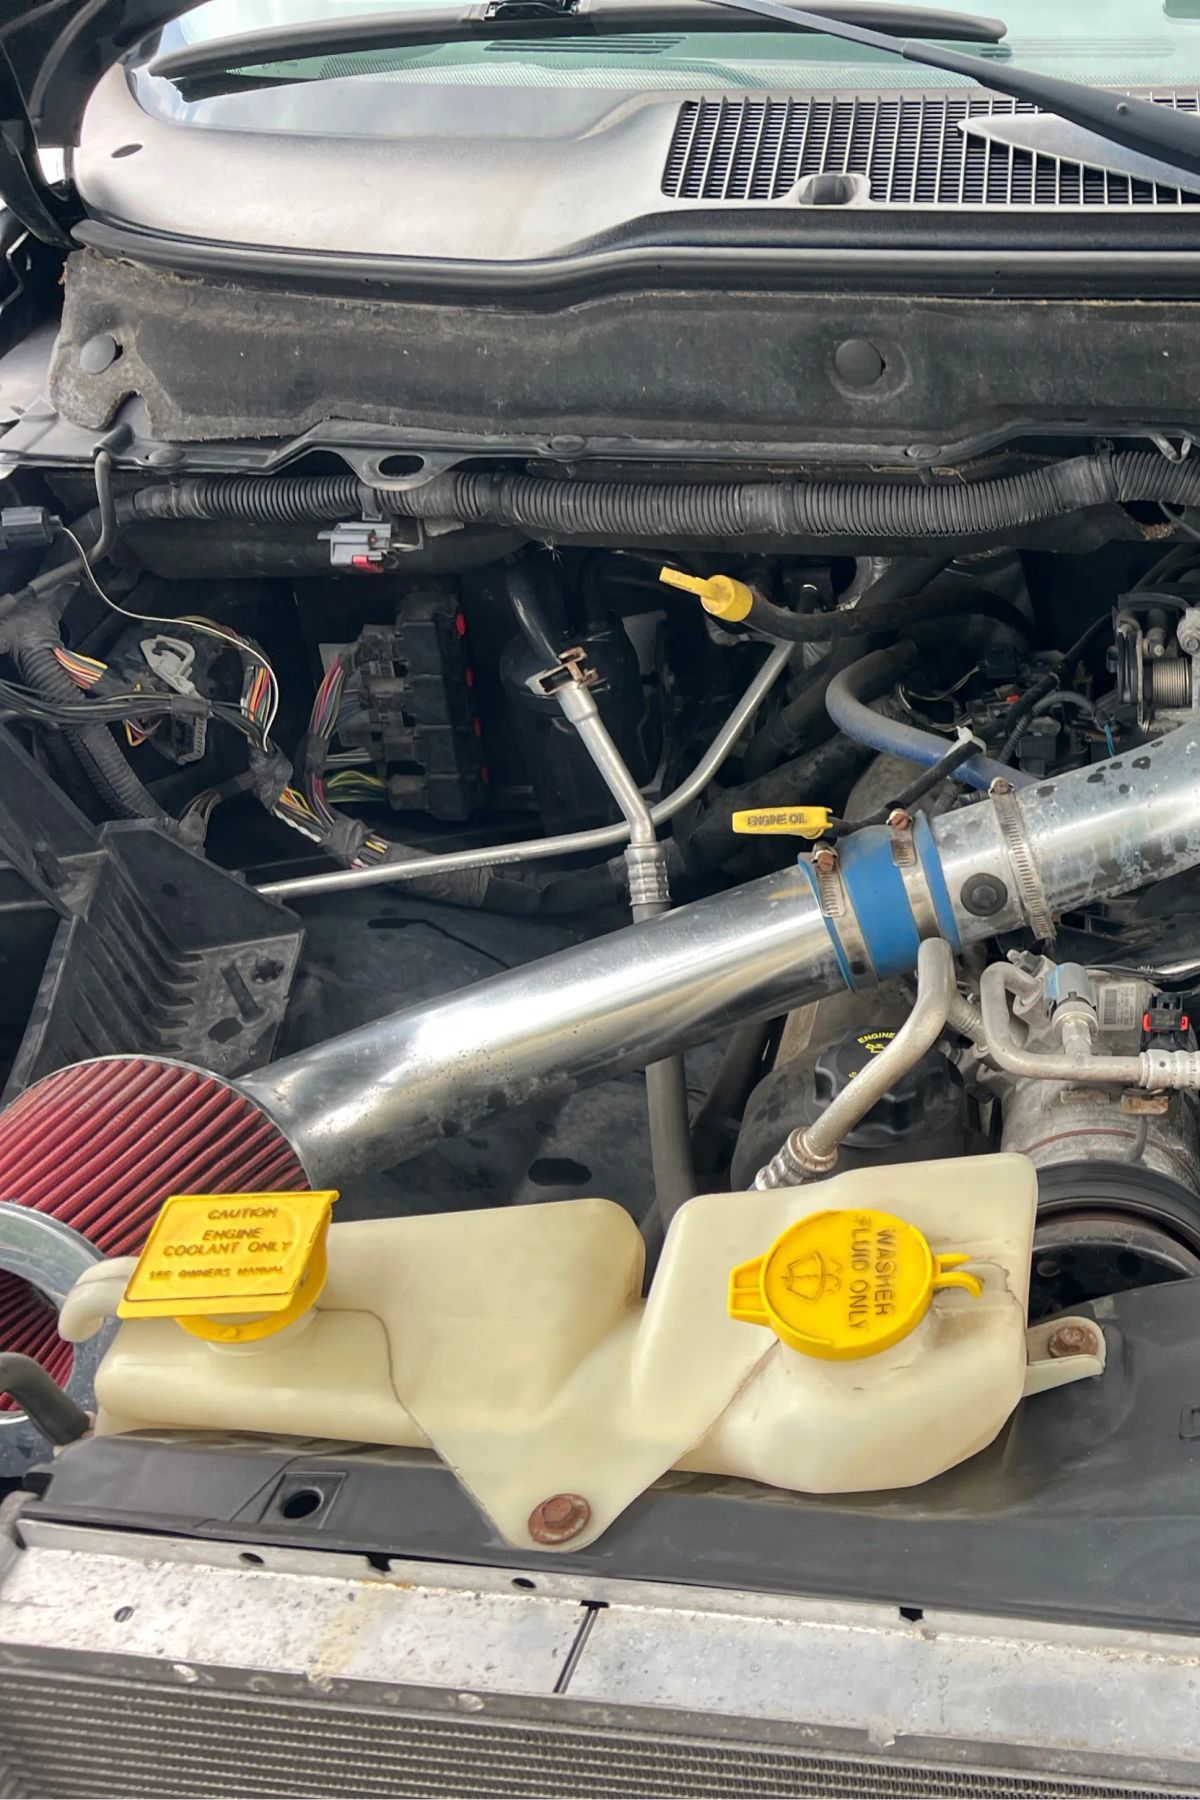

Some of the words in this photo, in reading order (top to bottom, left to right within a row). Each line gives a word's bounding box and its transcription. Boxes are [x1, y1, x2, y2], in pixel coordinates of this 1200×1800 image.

[747, 814, 787, 827] ENGINE
[788, 813, 808, 824] OIL
[857, 1031, 896, 1044] ENGINE
[207, 1207, 278, 1220] CAUTION
[202, 1227, 264, 1241] ENGINE
[162, 1243, 239, 1257] COOLANT
[247, 1241, 292, 1253] ONLY
[850, 1214, 871, 1272] FLUID
[177, 1267, 231, 1279] OWNERS
[874, 1228, 896, 1316] WASHER
[848, 1279, 870, 1328] ONLY
